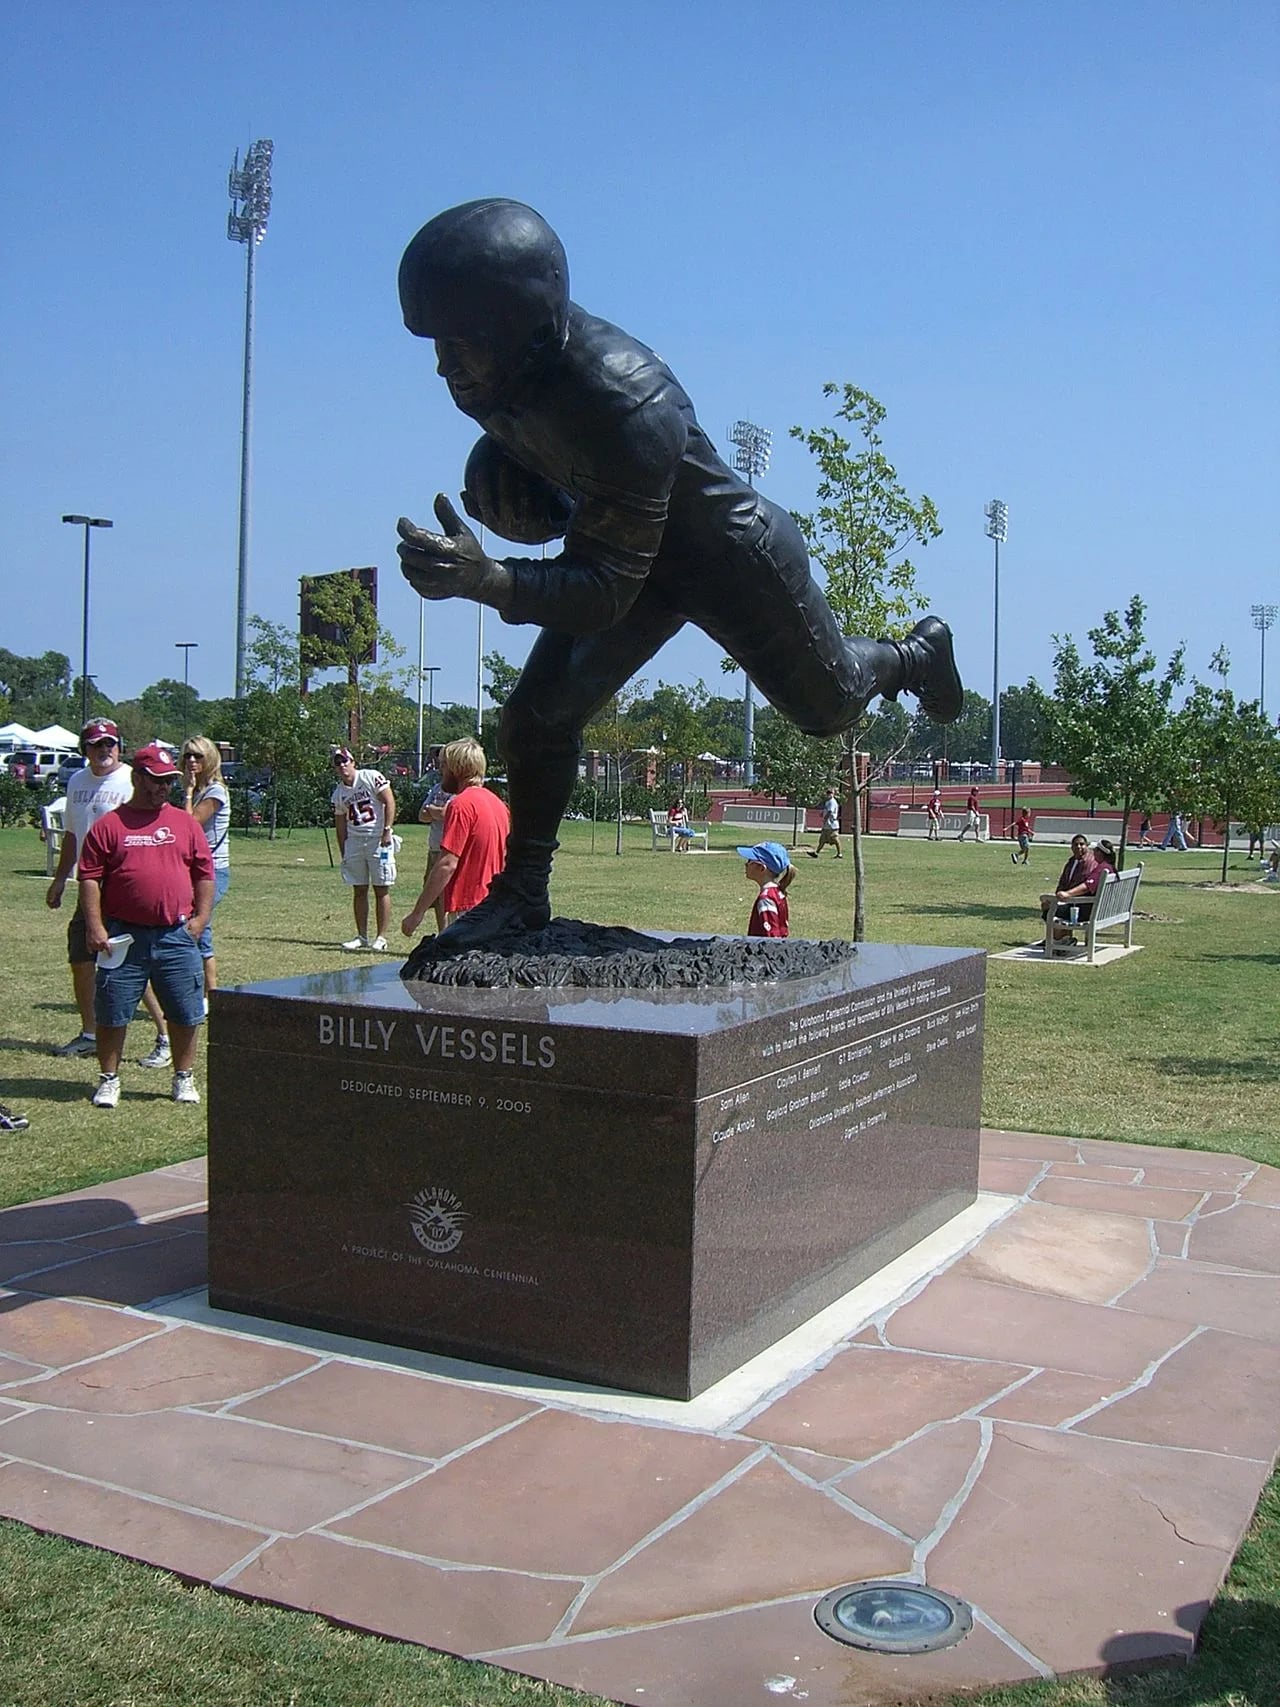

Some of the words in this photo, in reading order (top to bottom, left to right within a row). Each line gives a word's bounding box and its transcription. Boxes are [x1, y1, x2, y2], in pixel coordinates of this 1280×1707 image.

[800, 1012, 825, 1029] Oklahoma
[826, 1005, 850, 1020] Centennial
[851, 997, 876, 1012] Commission
[876, 993, 885, 1004] and
[893, 984, 911, 999] University
[847, 1015, 856, 1028] and
[319, 1014, 397, 1051] BILLY
[415, 1023, 556, 1068] VESSELS
[776, 1073, 798, 1089] Clayton
[803, 1063, 821, 1079] Bennett
[341, 1079, 403, 1098] DEDICATED
[409, 1087, 472, 1107] SEPTEMBER
[478, 1096, 489, 1109] 9,
[496, 1098, 532, 1114] 2005
[720, 1098, 734, 1111] Sam
[735, 1091, 751, 1106] Allen
[766, 1103, 788, 1121] Gaylord
[789, 1096, 809, 1112] Graham
[810, 1086, 829, 1103] Bennett
[713, 1126, 735, 1143] Claude
[736, 1117, 755, 1134] Arnold
[809, 1112, 833, 1131] Oklahoma
[833, 1102, 855, 1119] University
[413, 1186, 463, 1211] OKLAHOMA
[341, 1243, 348, 1253] A
[351, 1245, 388, 1259] PROJECT
[391, 1251, 404, 1262] OF
[408, 1254, 422, 1266] THE
[426, 1258, 480, 1275] OKLAHOMA
[483, 1268, 540, 1286] CENTENNIAL
